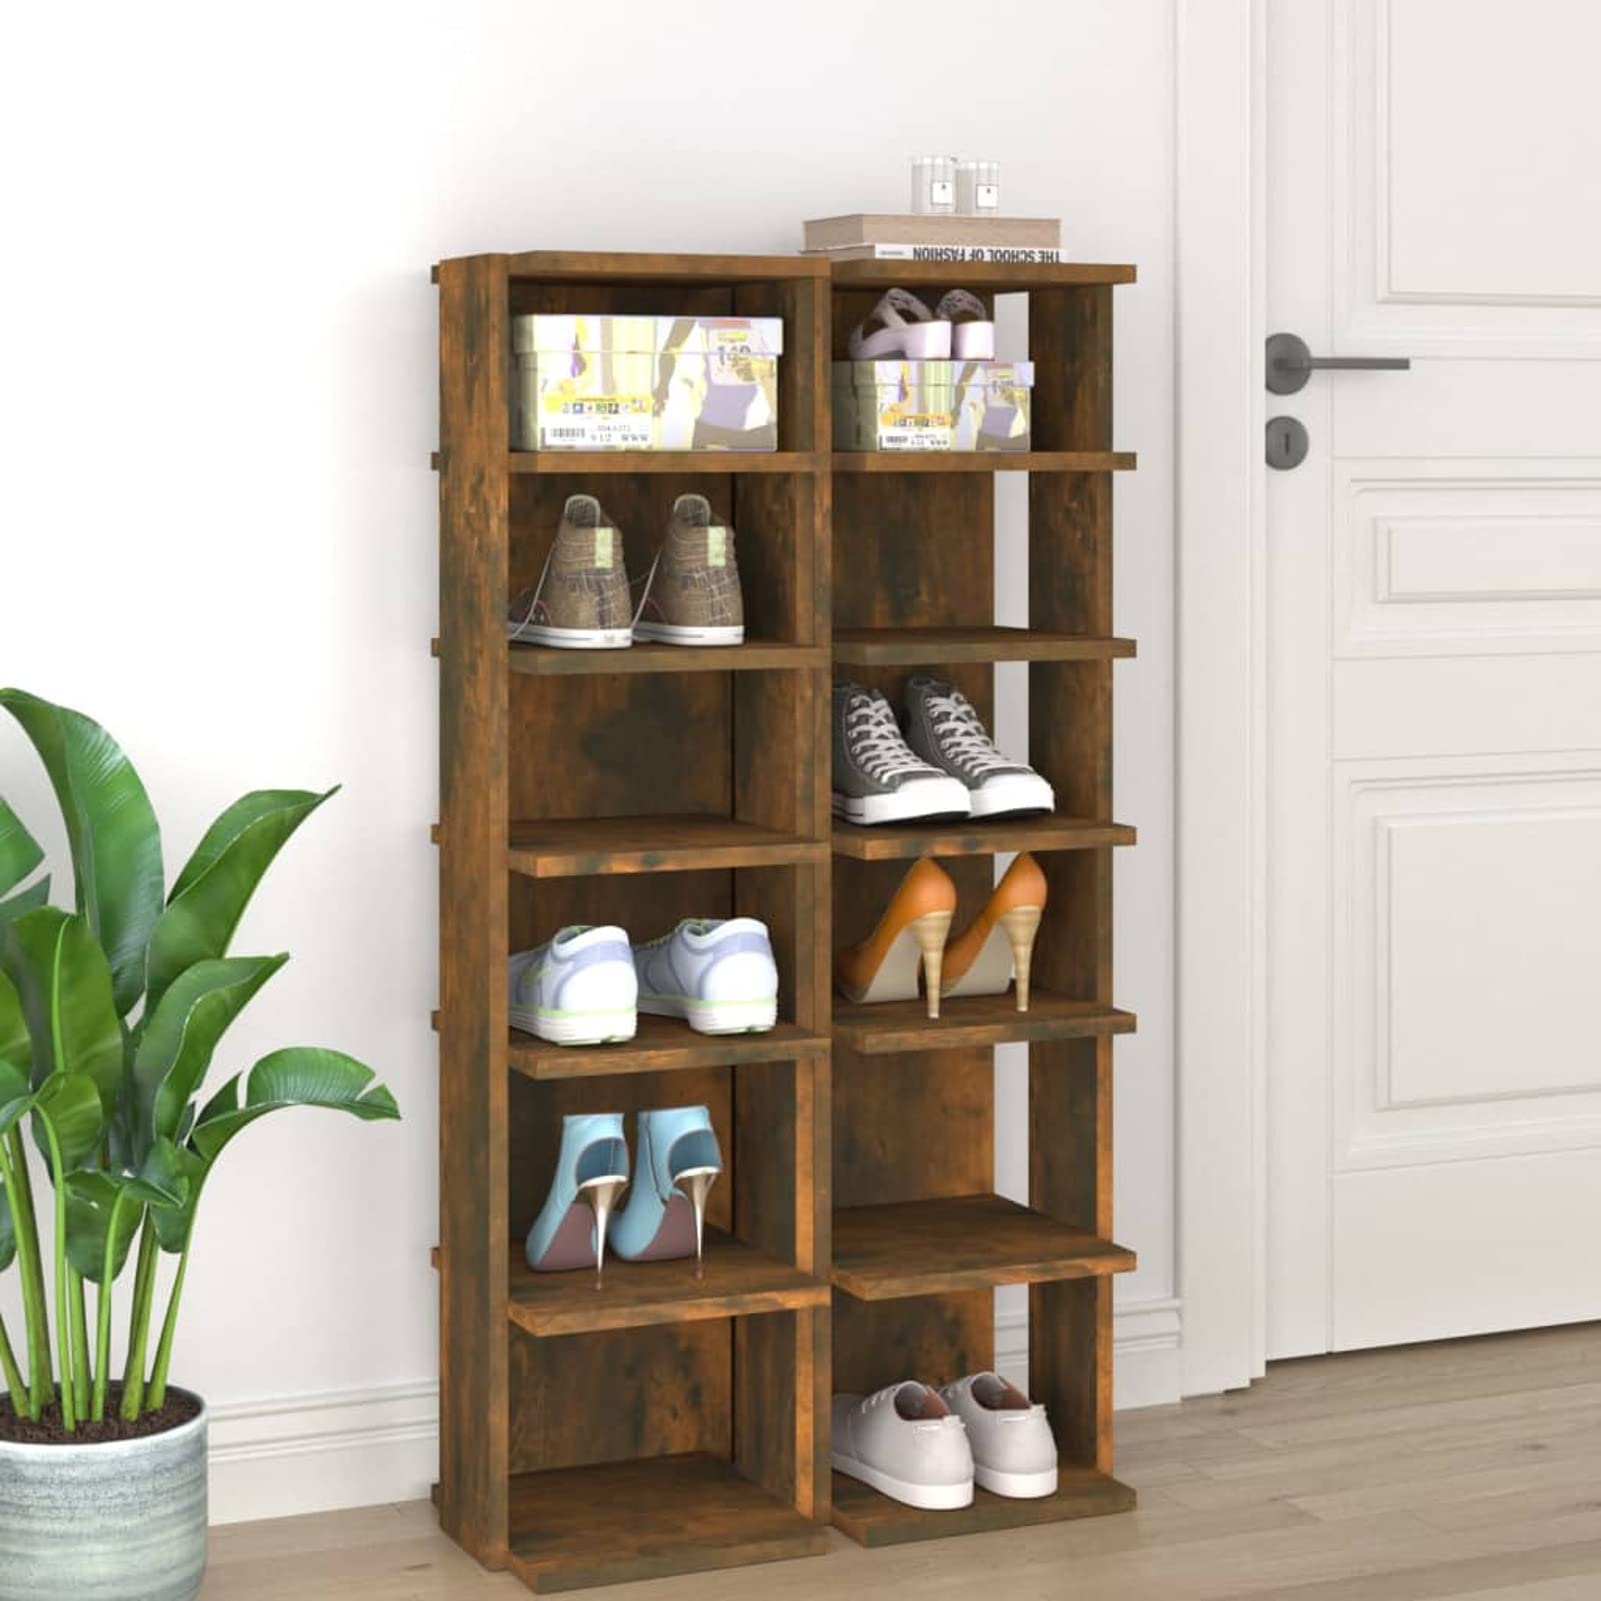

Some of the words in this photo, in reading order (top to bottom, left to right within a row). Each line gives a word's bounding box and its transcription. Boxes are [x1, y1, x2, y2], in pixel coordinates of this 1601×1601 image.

[912, 247, 966, 262] FASHION
[968, 248, 985, 262] OF
[987, 249, 1036, 264] SCHOOL
[1038, 250, 1060, 264] THE
